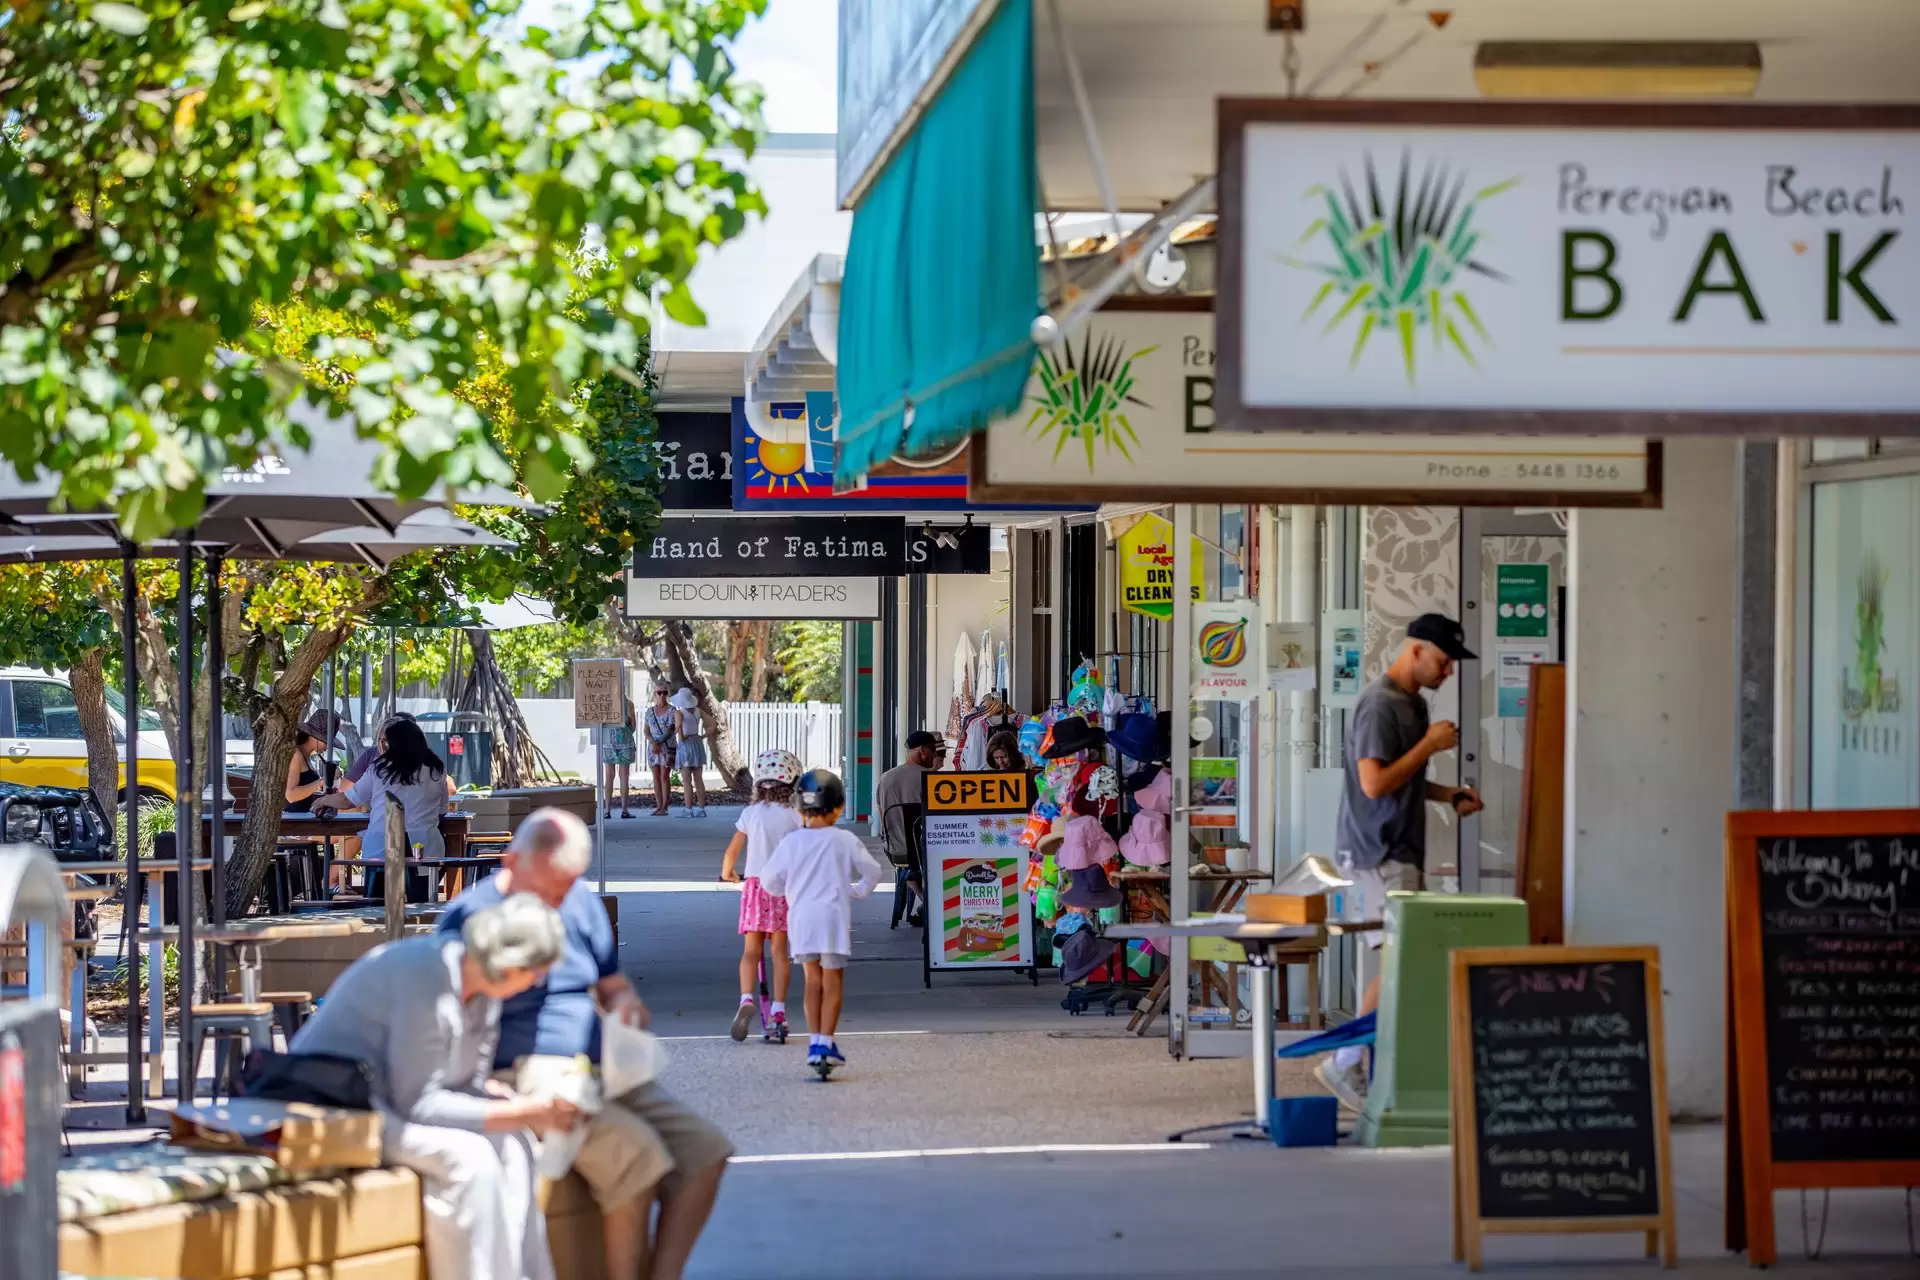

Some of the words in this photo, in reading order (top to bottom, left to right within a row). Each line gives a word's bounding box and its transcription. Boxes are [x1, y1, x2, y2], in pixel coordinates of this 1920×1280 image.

[1557, 162, 1734, 241] Peregian
[1764, 163, 1905, 218] Beach
[1561, 228, 1902, 324] BAK
[1426, 461, 1491, 479] Phone
[1516, 462, 1566, 480] 5448
[1576, 463, 1620, 480] 1366
[650, 536, 723, 559] Hand
[737, 536, 770, 558] of
[784, 536, 887, 558] Fatima
[1137, 544, 1166, 554] Local
[659, 583, 748, 601] BEDOUIN
[758, 584, 847, 602] TRADERS
[1126, 585, 1200, 601] CLEANS
[577, 669, 617, 678] PLEASE
[585, 680, 610, 689] WAIT
[1200, 678, 1247, 687] FLAVOUR
[584, 693, 612, 703] HERE
[577, 711, 620, 721] SEATED
[933, 779, 1020, 804] OPEN
[933, 822, 968, 830] SUMMER
[927, 831, 975, 839] ESSENTIALS
[963, 885, 1000, 898] MERRY
[963, 898, 1000, 907] CHRISTMAS
[1518, 967, 1588, 993] NEW
